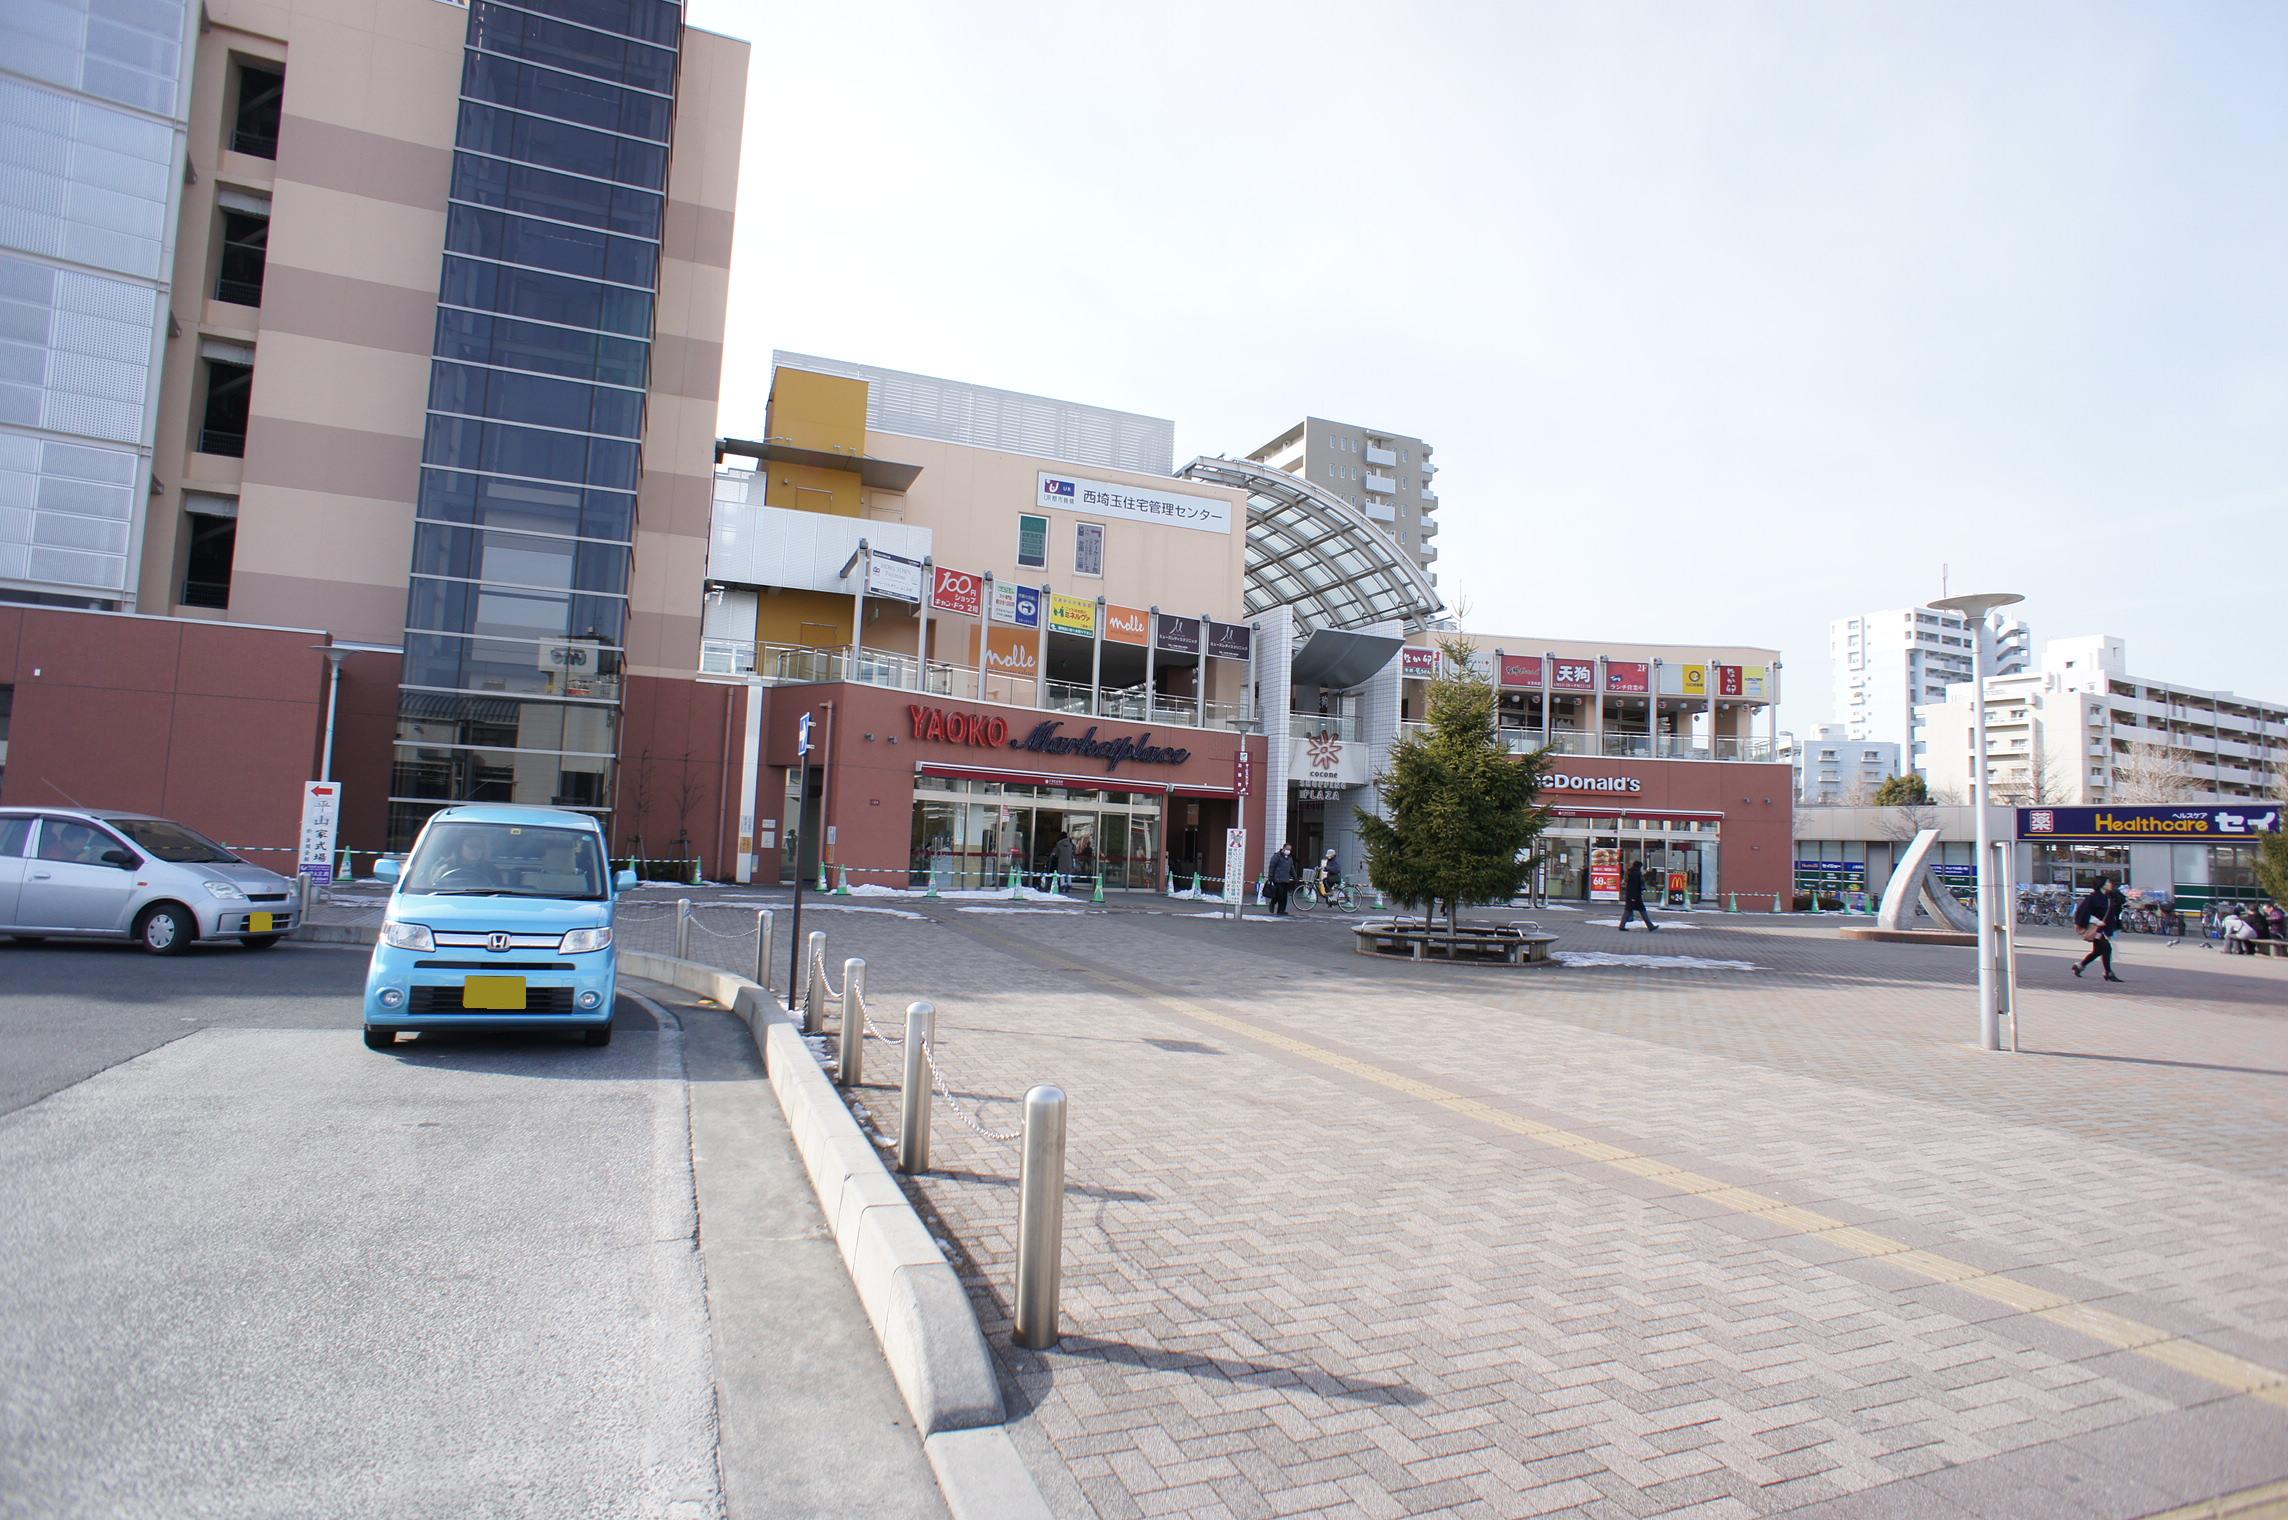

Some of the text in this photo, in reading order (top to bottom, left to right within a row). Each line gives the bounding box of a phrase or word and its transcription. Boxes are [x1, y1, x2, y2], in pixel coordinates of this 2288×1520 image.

[1083, 489, 1223, 521] 西埼玉住宅管理センター
[1404, 653, 1431, 665] なか卯
[1556, 665, 1591, 682] 天狗
[1637, 664, 1647, 672] 2F
[1725, 667, 1737, 694] なか卯
[908, 704, 1009, 748] YAOKO
[1310, 770, 1338, 778] cocone
[1534, 774, 1641, 792] cDonald's
[1303, 789, 1340, 800] PLAZA
[2095, 813, 2208, 832] Healthcare
